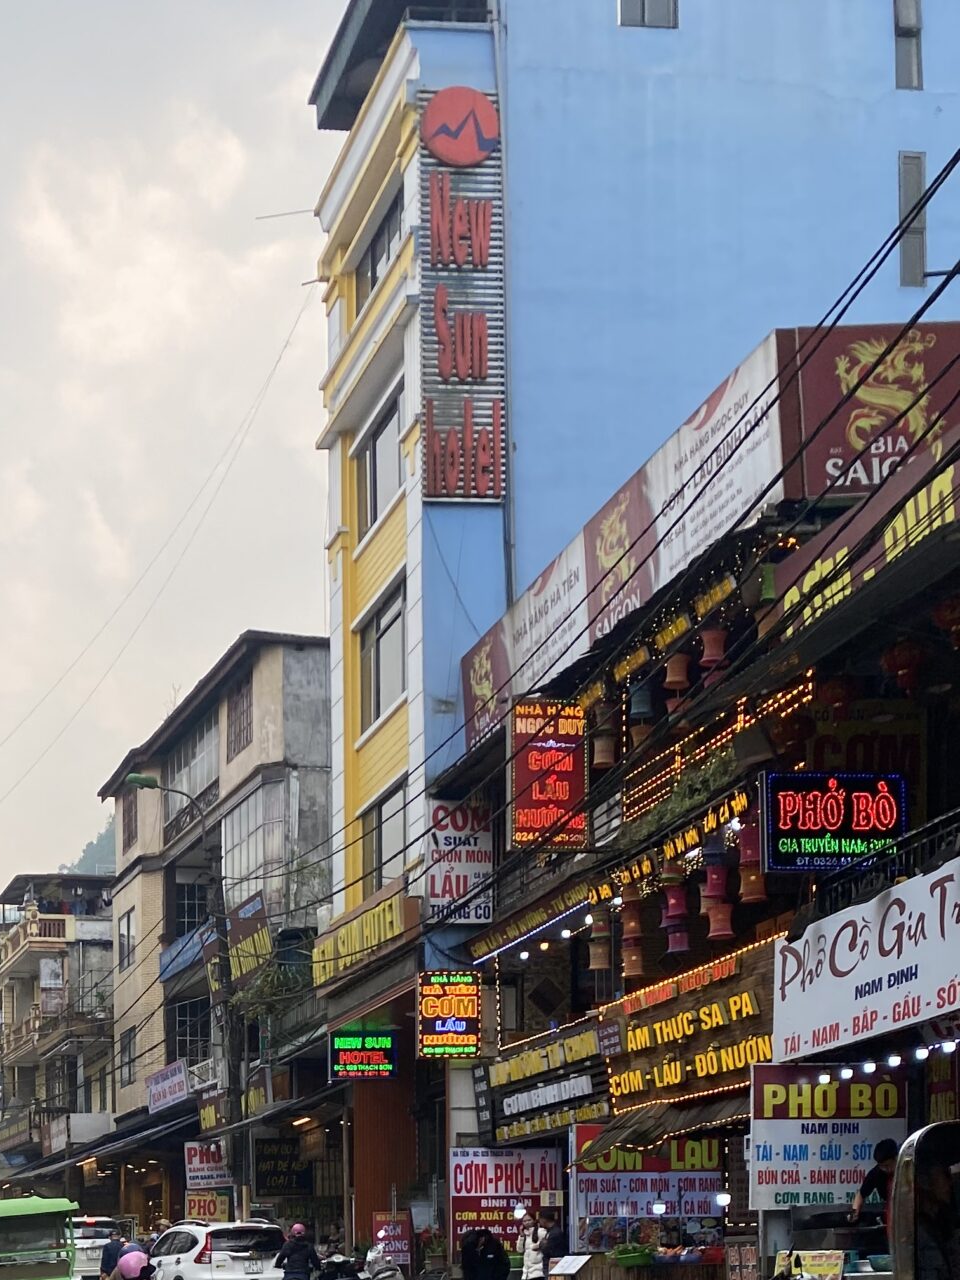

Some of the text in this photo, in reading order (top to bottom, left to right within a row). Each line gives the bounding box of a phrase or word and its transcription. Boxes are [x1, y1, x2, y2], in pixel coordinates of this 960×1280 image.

[429, 170, 493, 267] New
[434, 282, 489, 381] Sun
[426, 397, 502, 498] hotel
[871, 436, 909, 454] BIA
[825, 456, 920, 487] SAIG
[516, 702, 543, 716] NHÀ
[516, 717, 554, 737] NGỌC
[558, 718, 586, 736] DUY
[528, 749, 574, 772] CƠM
[778, 778, 898, 831] PHỞ BÒ
[778, 837, 799, 854] GIA
[841, 837, 868, 854] NAM
[430, 848, 462, 866] CHỌN
[429, 863, 469, 899] LẨU
[360, 894, 401, 955] HOTEL
[779, 932, 828, 1002] Phở
[828, 915, 873, 978] Cồ
[877, 897, 928, 960] Gia
[449, 974, 473, 983] HÀNG
[678, 968, 711, 995] NGỌC
[712, 956, 737, 982] DUY
[854, 963, 920, 1001] NAM ĐỊNH
[422, 995, 477, 1017] CƠM
[626, 1020, 651, 1053] ẨM
[652, 1010, 695, 1045] THỰC
[698, 1003, 724, 1031] SA
[728, 991, 754, 1021] PA
[334, 1037, 392, 1049] NEW SUN
[784, 1031, 801, 1057] TÁI
[811, 1022, 841, 1050] NẠM
[339, 1051, 388, 1065] HOTEL
[611, 1034, 774, 1097] CƠM LẨU ĐỒ NƯỚN
[850, 1075, 899, 1119] BÒ
[801, 1122, 860, 1137] NAM ĐỊNH
[755, 1142, 773, 1163] TÁI
[578, 1176, 598, 1194] CƠM
[629, 1176, 649, 1194] CƠM
[650, 1174, 670, 1194] MÓN
[678, 1176, 697, 1194] CƠM
[698, 1177, 722, 1194] RANG
[757, 1162, 866, 1186] BÚN CHẢ BÁNH CUỐN
[480, 1197, 507, 1208] BÌNH
[607, 1197, 619, 1216] CÁ
[684, 1198, 696, 1215] CÁ
[774, 1190, 835, 1205] CƠM RANG
[455, 1210, 478, 1221] CƠM
[479, 1208, 505, 1221] XUẤT
